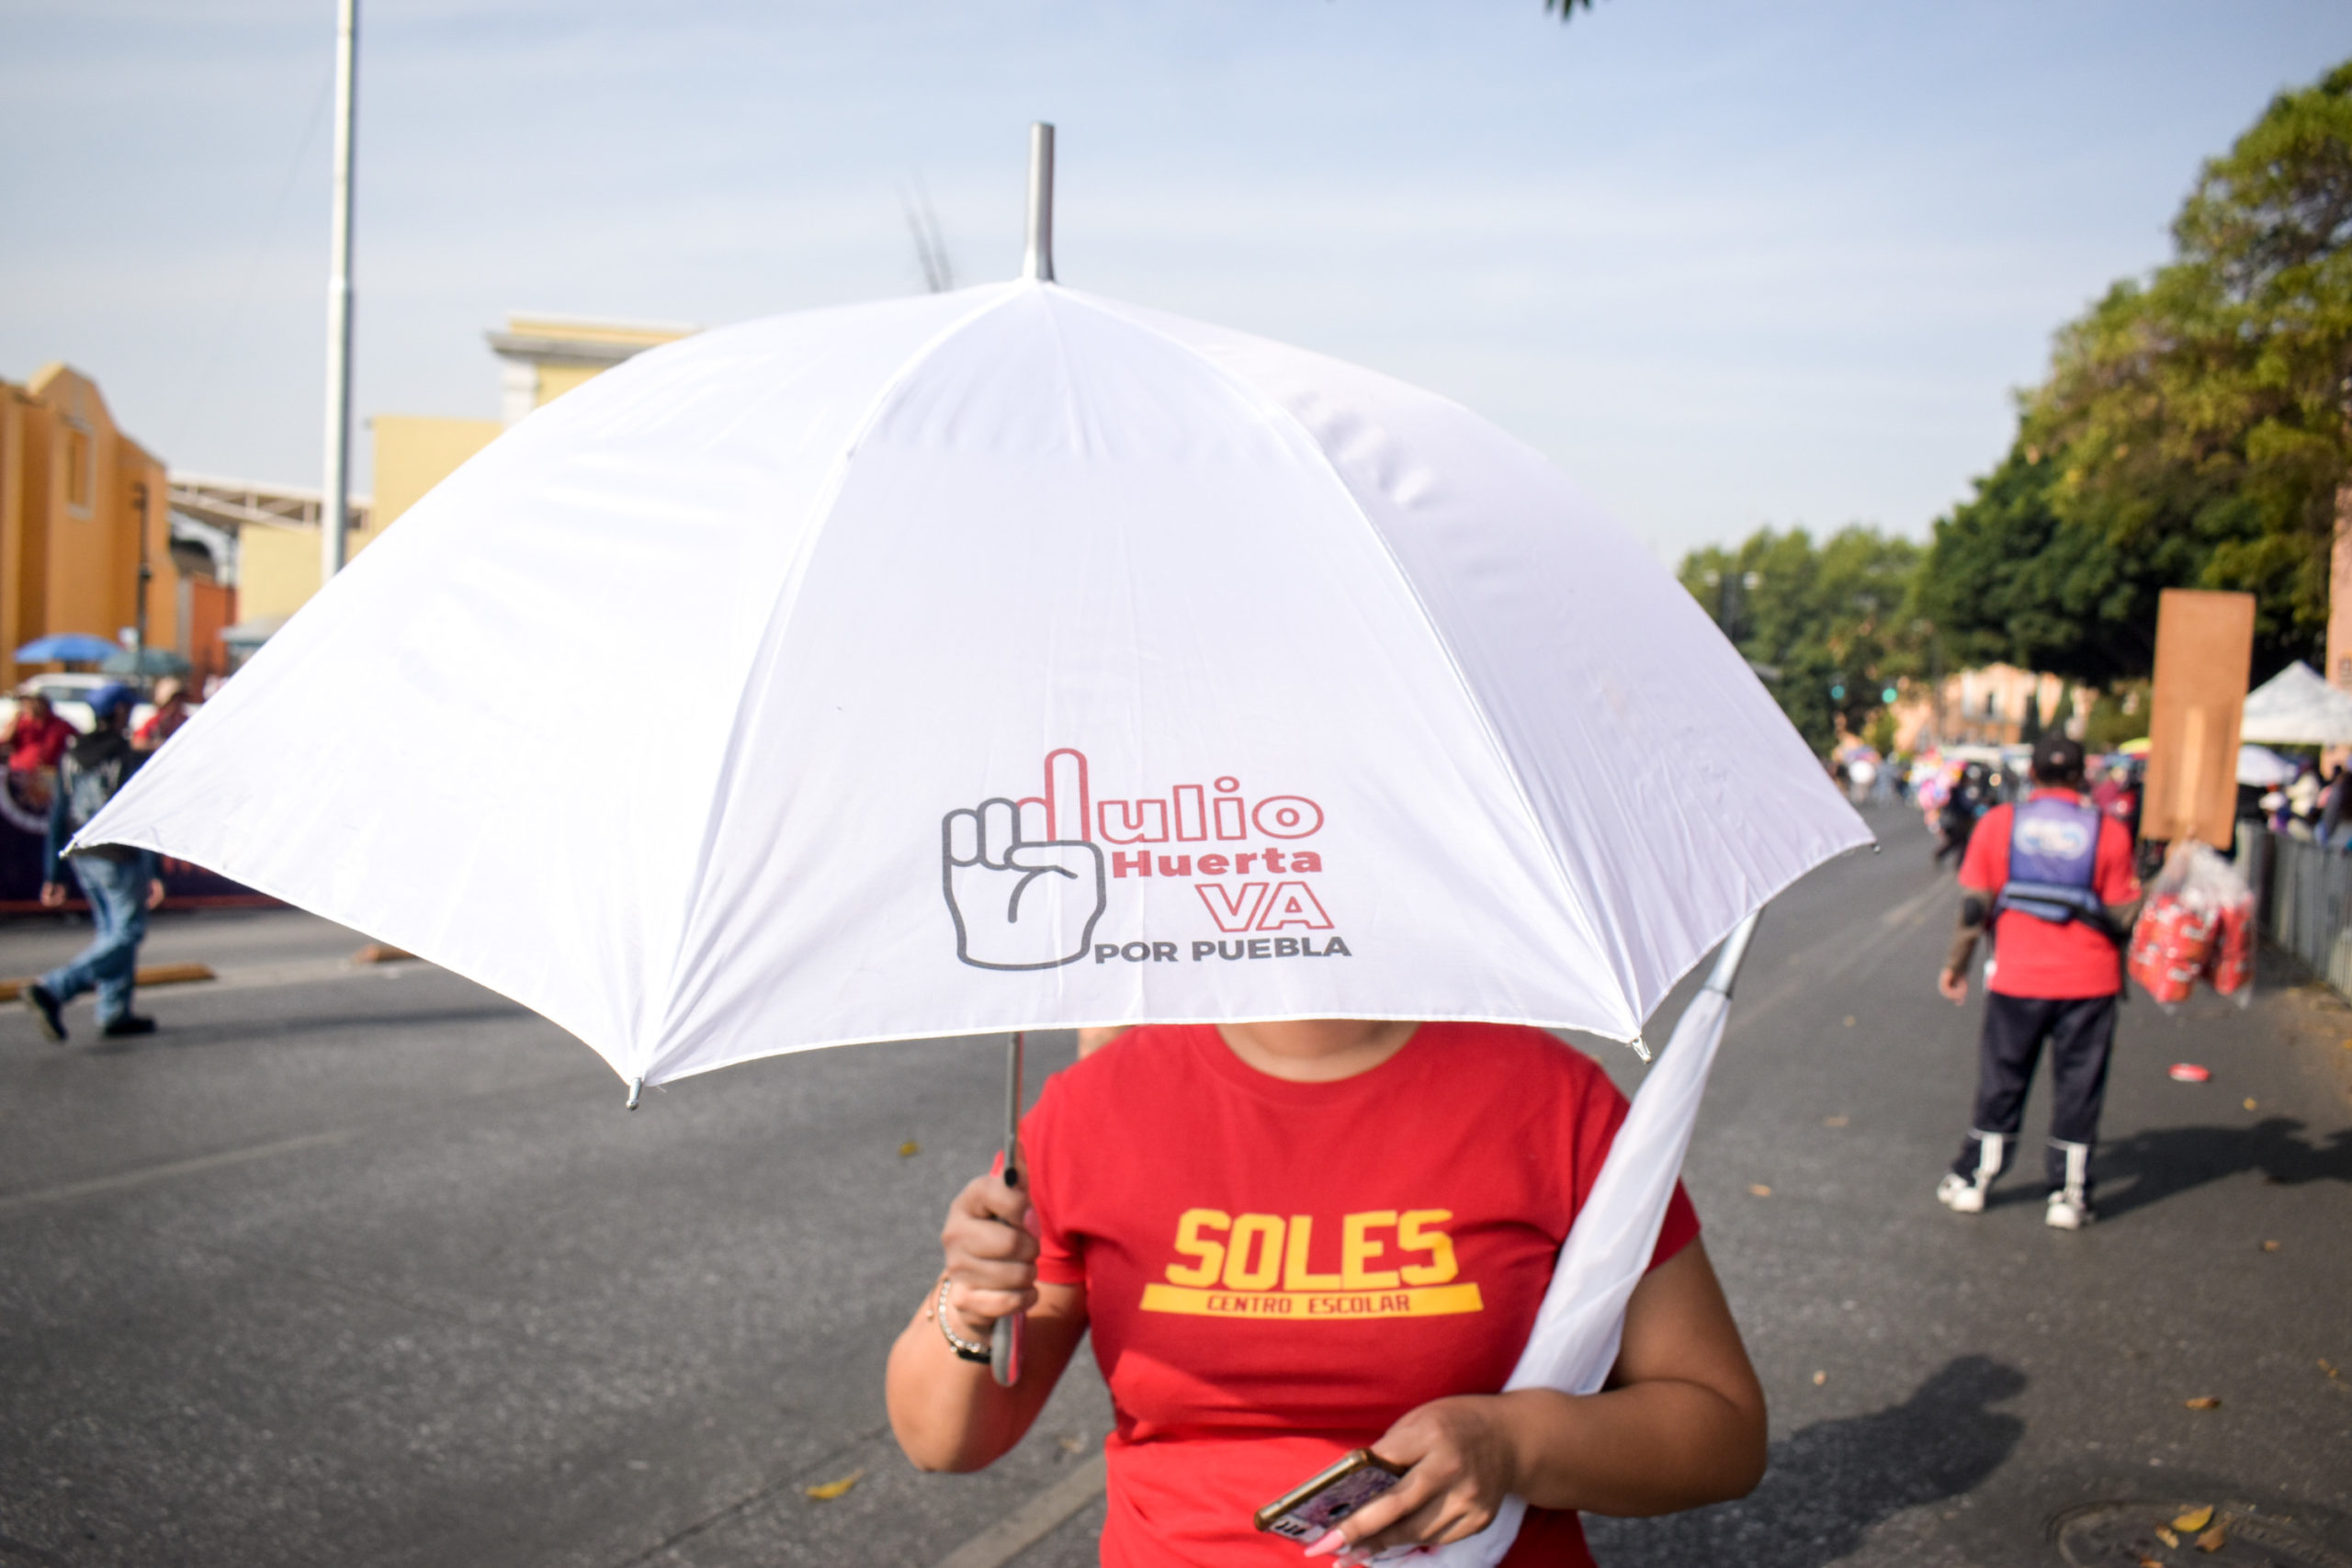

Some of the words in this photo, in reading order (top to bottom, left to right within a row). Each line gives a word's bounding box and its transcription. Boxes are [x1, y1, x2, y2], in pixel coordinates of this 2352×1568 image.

[1112, 848, 1323, 878] Huerta
[1194, 880, 1336, 934] VA
[1093, 941, 1179, 964] POR
[1191, 936, 1352, 963] PUEBLA
[1165, 1208, 1459, 1292] SOLES
[1206, 1294, 1292, 1314] CENTRO
[1307, 1293, 1411, 1314] ESCOLAR
